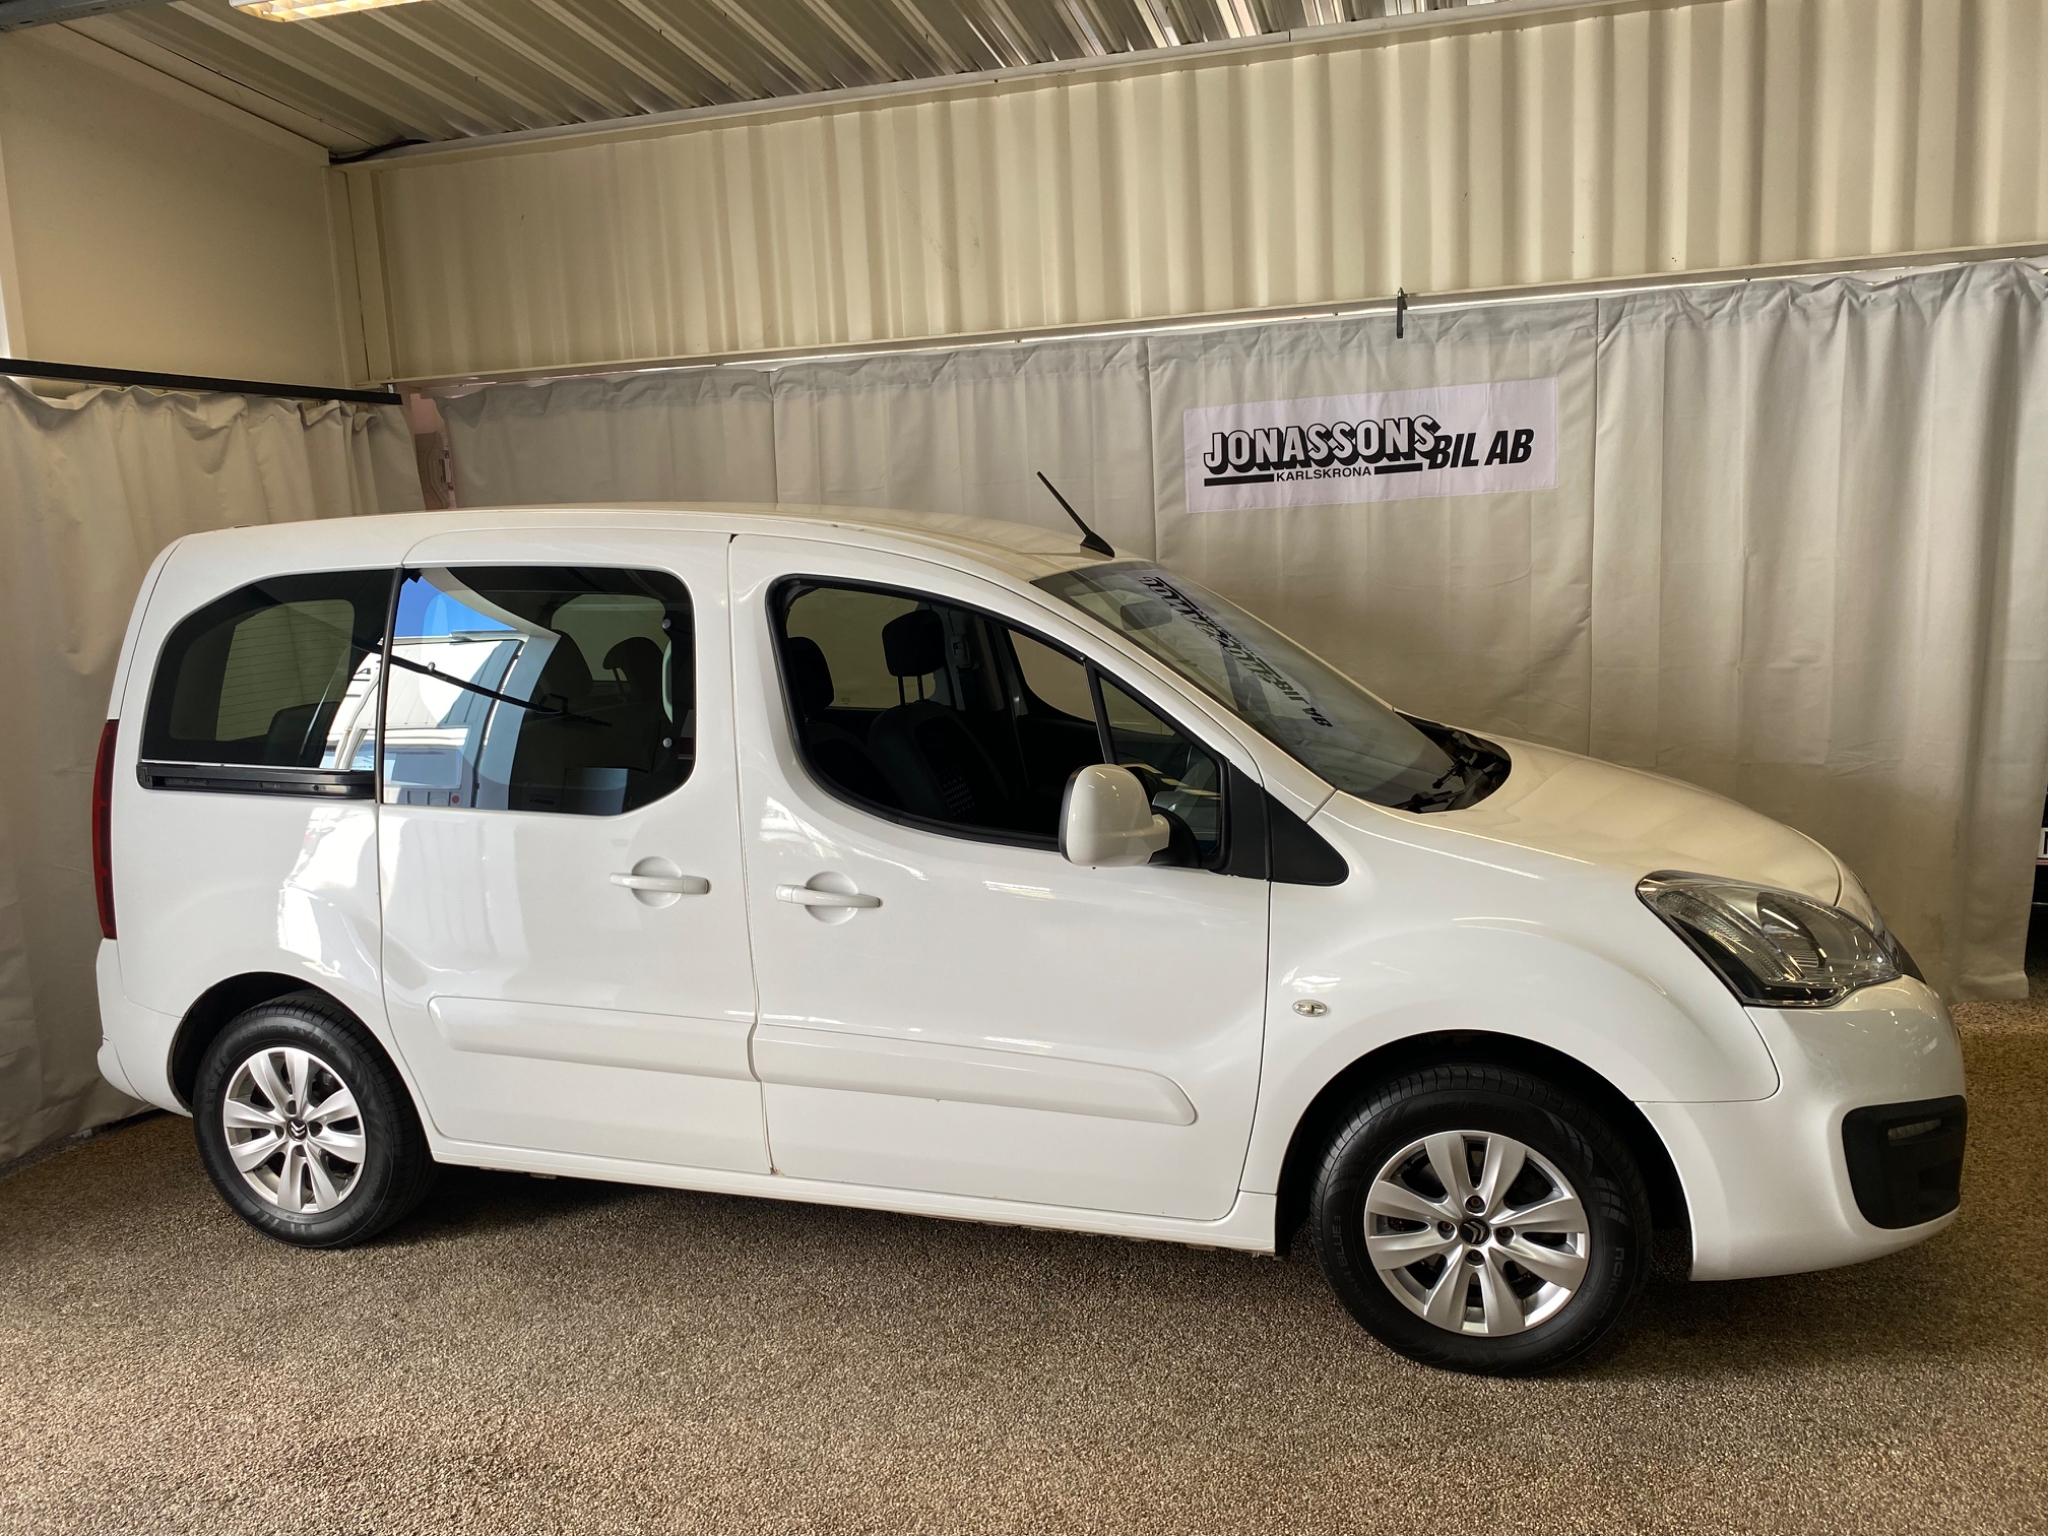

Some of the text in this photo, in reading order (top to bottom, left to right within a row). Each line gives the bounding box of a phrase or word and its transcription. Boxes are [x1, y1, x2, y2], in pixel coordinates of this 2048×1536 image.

[1203, 414, 1534, 475] JONASSONS BIL AB
[1276, 465, 1372, 483] KARLSKRONA
